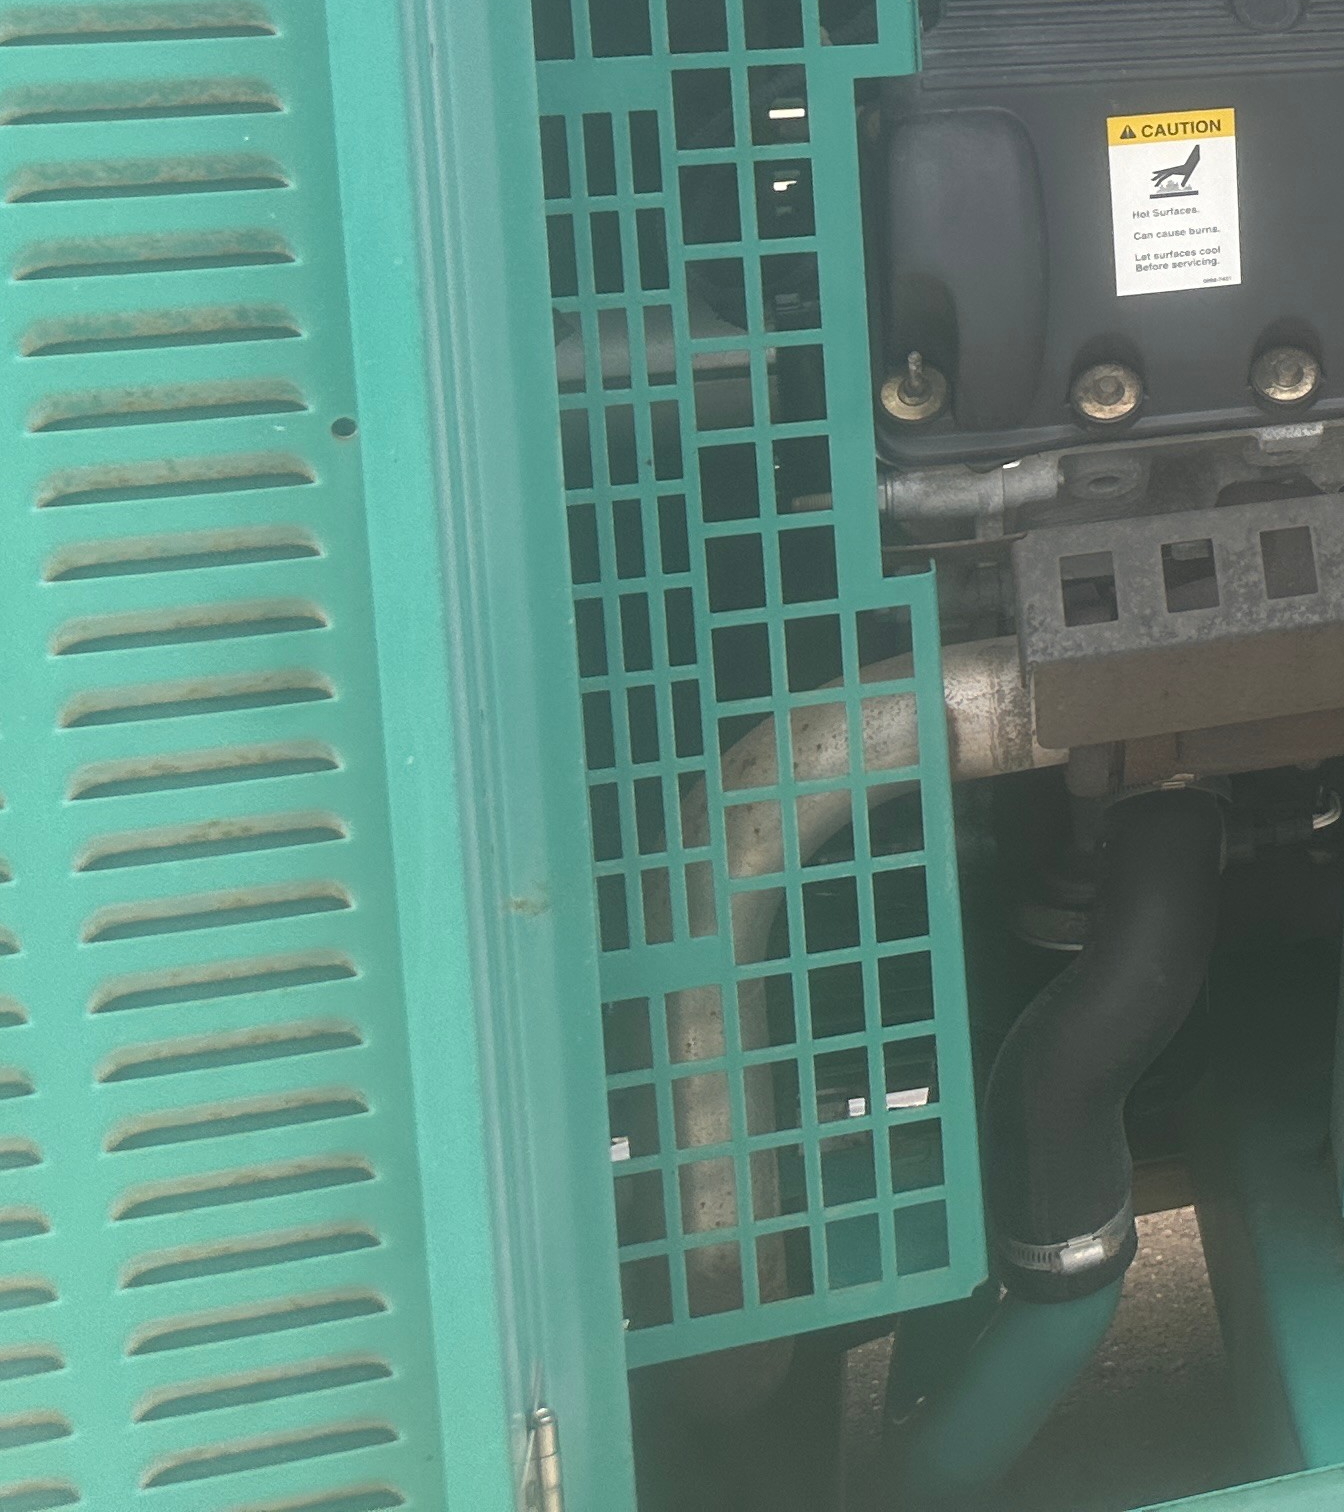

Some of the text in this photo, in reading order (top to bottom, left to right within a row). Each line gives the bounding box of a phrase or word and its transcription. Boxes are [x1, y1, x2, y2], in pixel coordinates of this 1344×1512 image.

[1142, 119, 1222, 138] CAUTION
[1133, 207, 1200, 219] Hot Surfaces.
[1134, 226, 1220, 240] Can cause burns.
[1135, 246, 1220, 261] Let surfaces cool
[1136, 258, 1220, 272] Before servicing.
